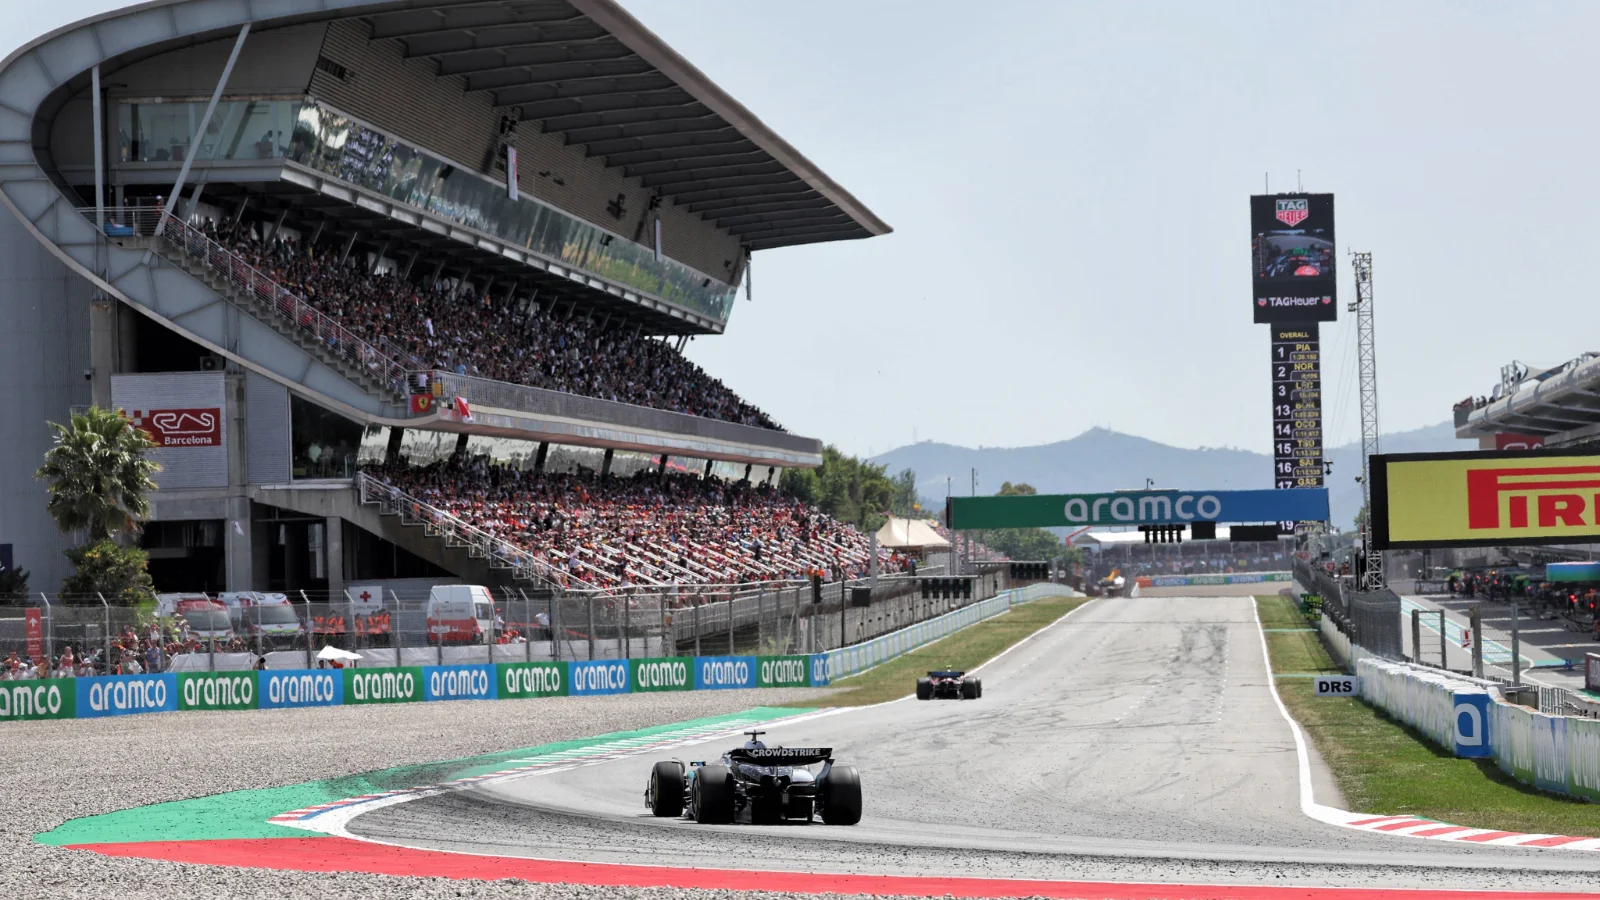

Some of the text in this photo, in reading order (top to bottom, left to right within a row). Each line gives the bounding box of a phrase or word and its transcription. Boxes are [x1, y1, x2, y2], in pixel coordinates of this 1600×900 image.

[1281, 201, 1305, 210] TAG
[1278, 210, 1307, 225] HEUER
[1277, 347, 1284, 358] 1
[1278, 366, 1286, 377] 2
[1278, 385, 1286, 396] 3
[1275, 405, 1290, 416] 13
[1276, 424, 1291, 435] 14
[164, 435, 212, 445] Barcelona
[1276, 443, 1291, 454] 15
[1277, 462, 1292, 473] 16
[1467, 466, 1600, 529] PIR
[1064, 494, 1222, 522] aramco
[1279, 520, 1293, 530] 19
[575, 664, 626, 690] aramco
[637, 662, 687, 687] aramco
[703, 661, 748, 685] aramco
[761, 660, 804, 683] aramco
[353, 672, 414, 699] aramco
[431, 670, 488, 696] aramco
[506, 667, 560, 693] aramco
[1318, 681, 1353, 693] DRS
[90, 679, 167, 711] aramco
[184, 676, 253, 706] aramco
[269, 675, 334, 703] aramco
[752, 748, 821, 757] CROWDSTRIKE
